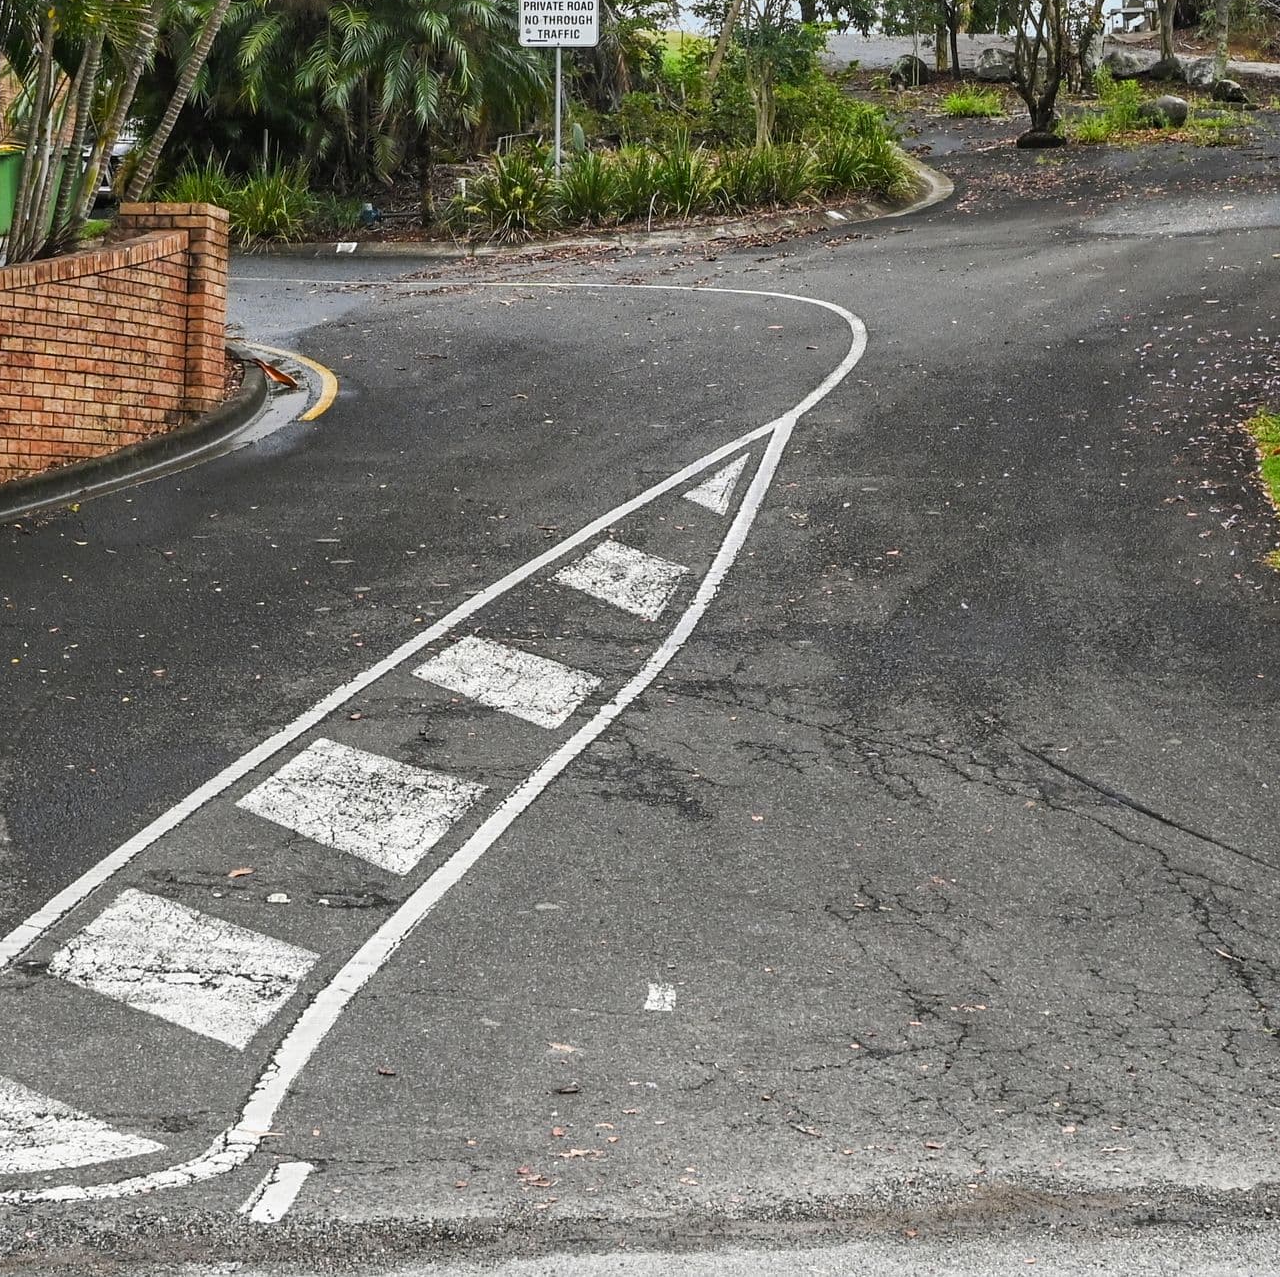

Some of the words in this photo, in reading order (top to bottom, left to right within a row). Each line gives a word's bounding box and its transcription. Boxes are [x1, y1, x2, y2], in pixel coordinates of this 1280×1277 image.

[523, 1, 564, 11] PRIVATE
[567, 1, 594, 11] ROAD
[524, 15, 539, 25] NO
[543, 15, 593, 25] THROUGH
[537, 29, 580, 39] TRAFFIC
